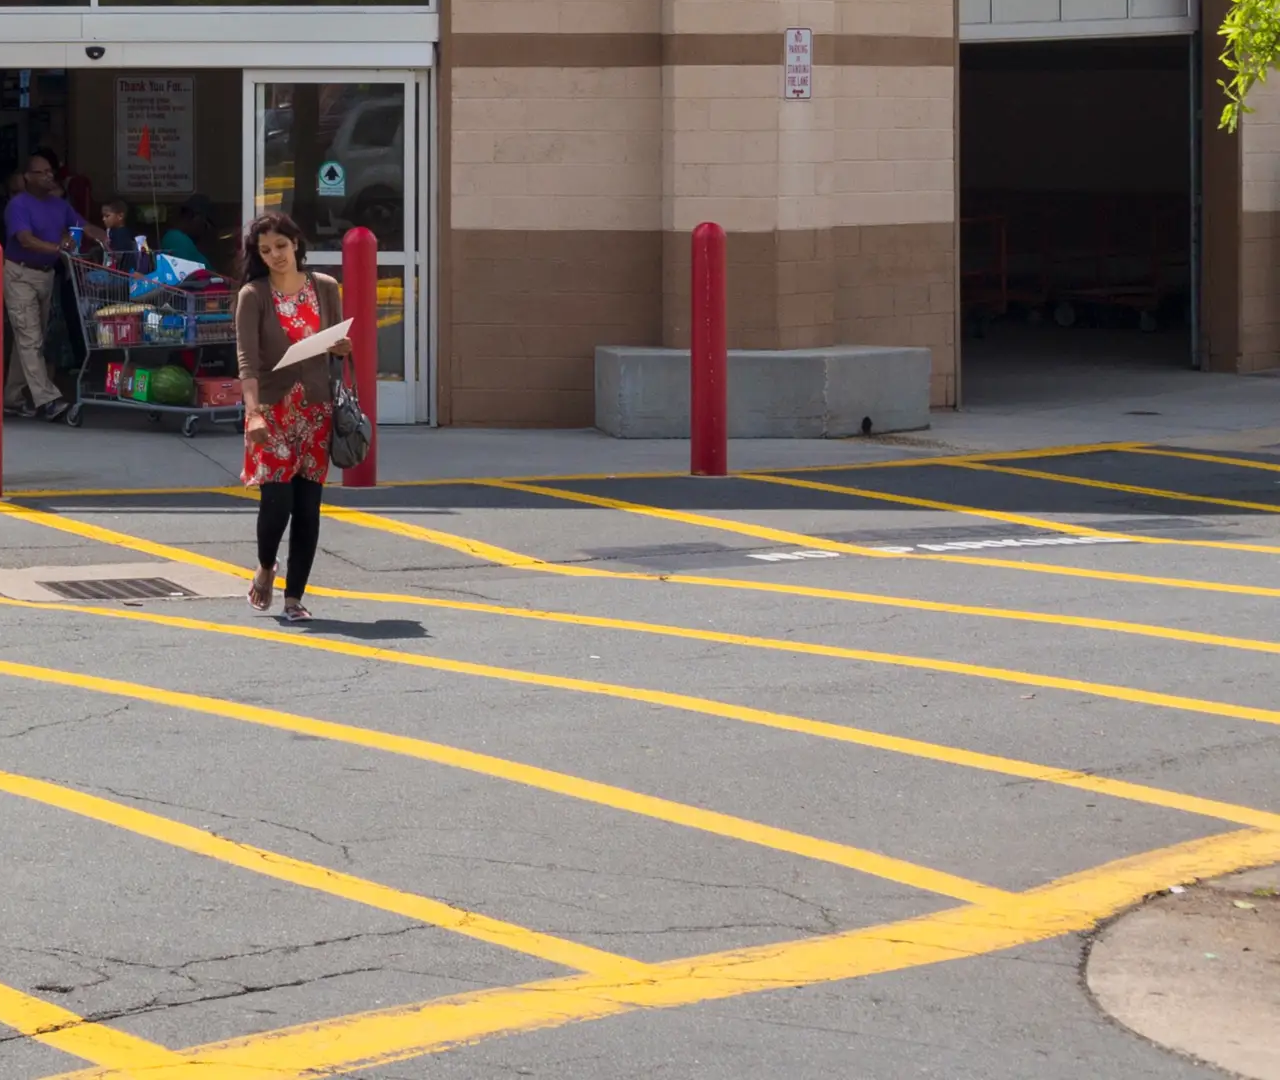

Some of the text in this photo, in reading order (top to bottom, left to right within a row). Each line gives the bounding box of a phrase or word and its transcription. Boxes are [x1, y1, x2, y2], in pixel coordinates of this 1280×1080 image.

[119, 80, 146, 92] Thank
[149, 80, 165, 92] You
[746, 550, 840, 562] NO
